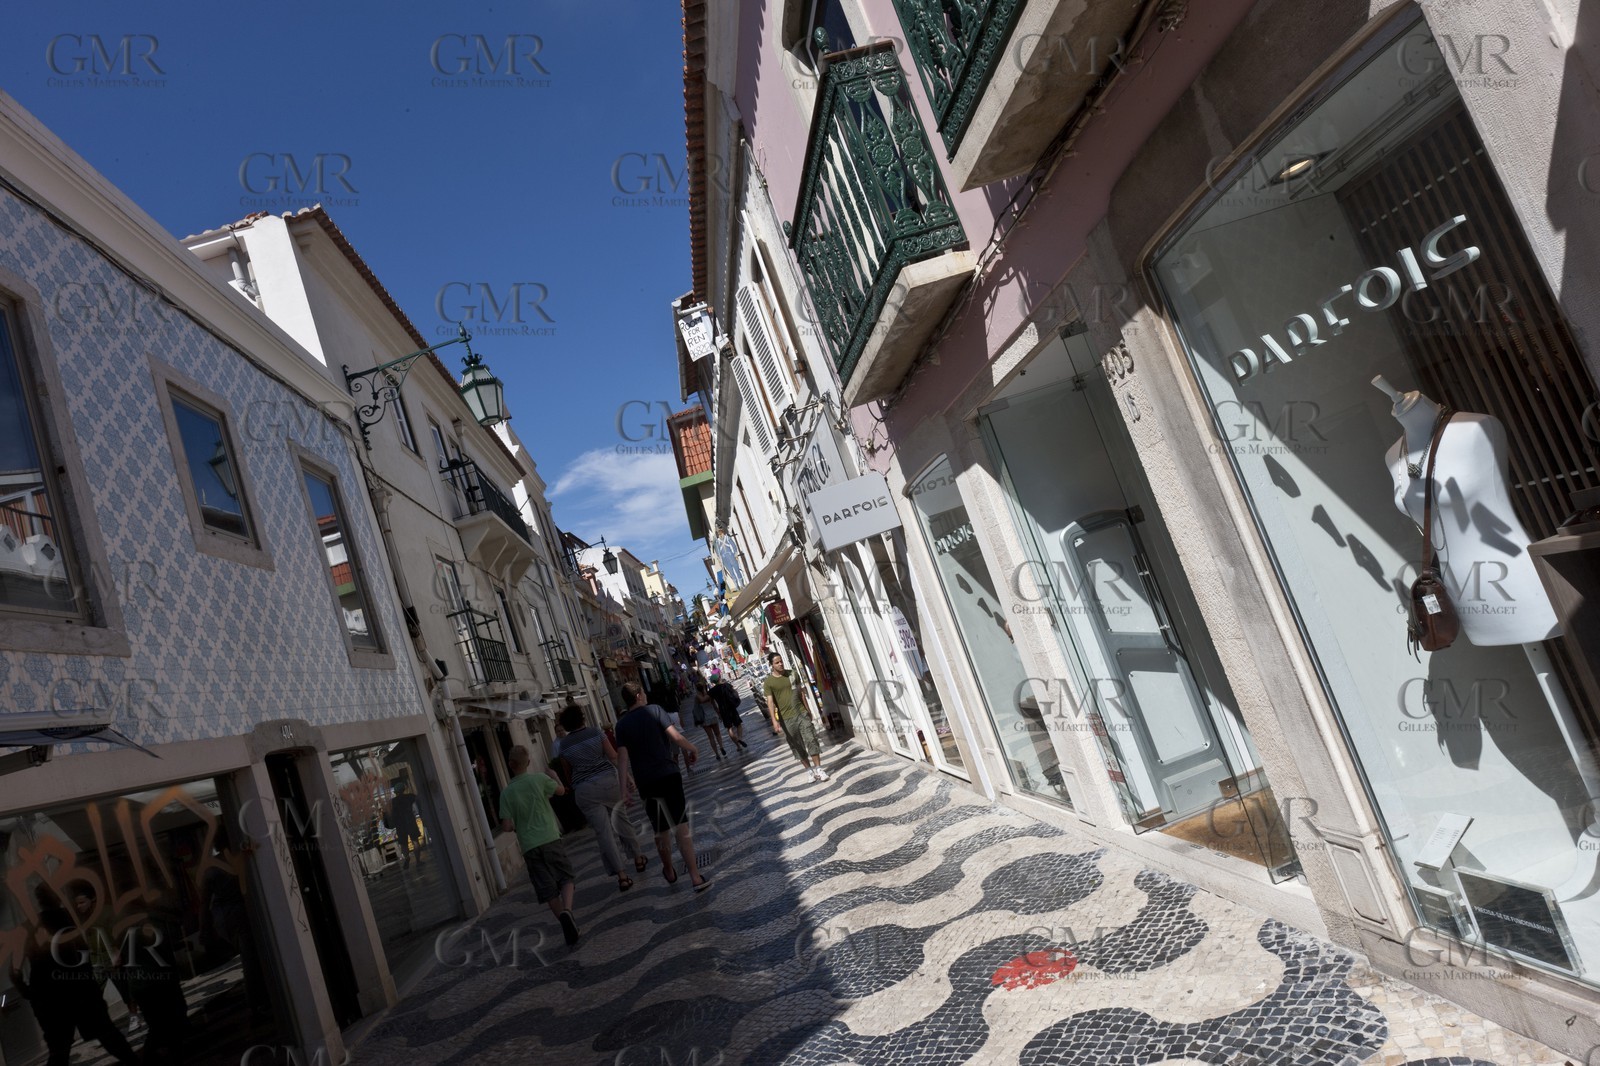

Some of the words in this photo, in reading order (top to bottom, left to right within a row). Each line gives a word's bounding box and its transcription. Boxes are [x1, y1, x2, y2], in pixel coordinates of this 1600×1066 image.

[1229, 214, 1481, 386] PARFOIS
[688, 326, 701, 337] FOR
[822, 495, 888, 525] PARFOIS
